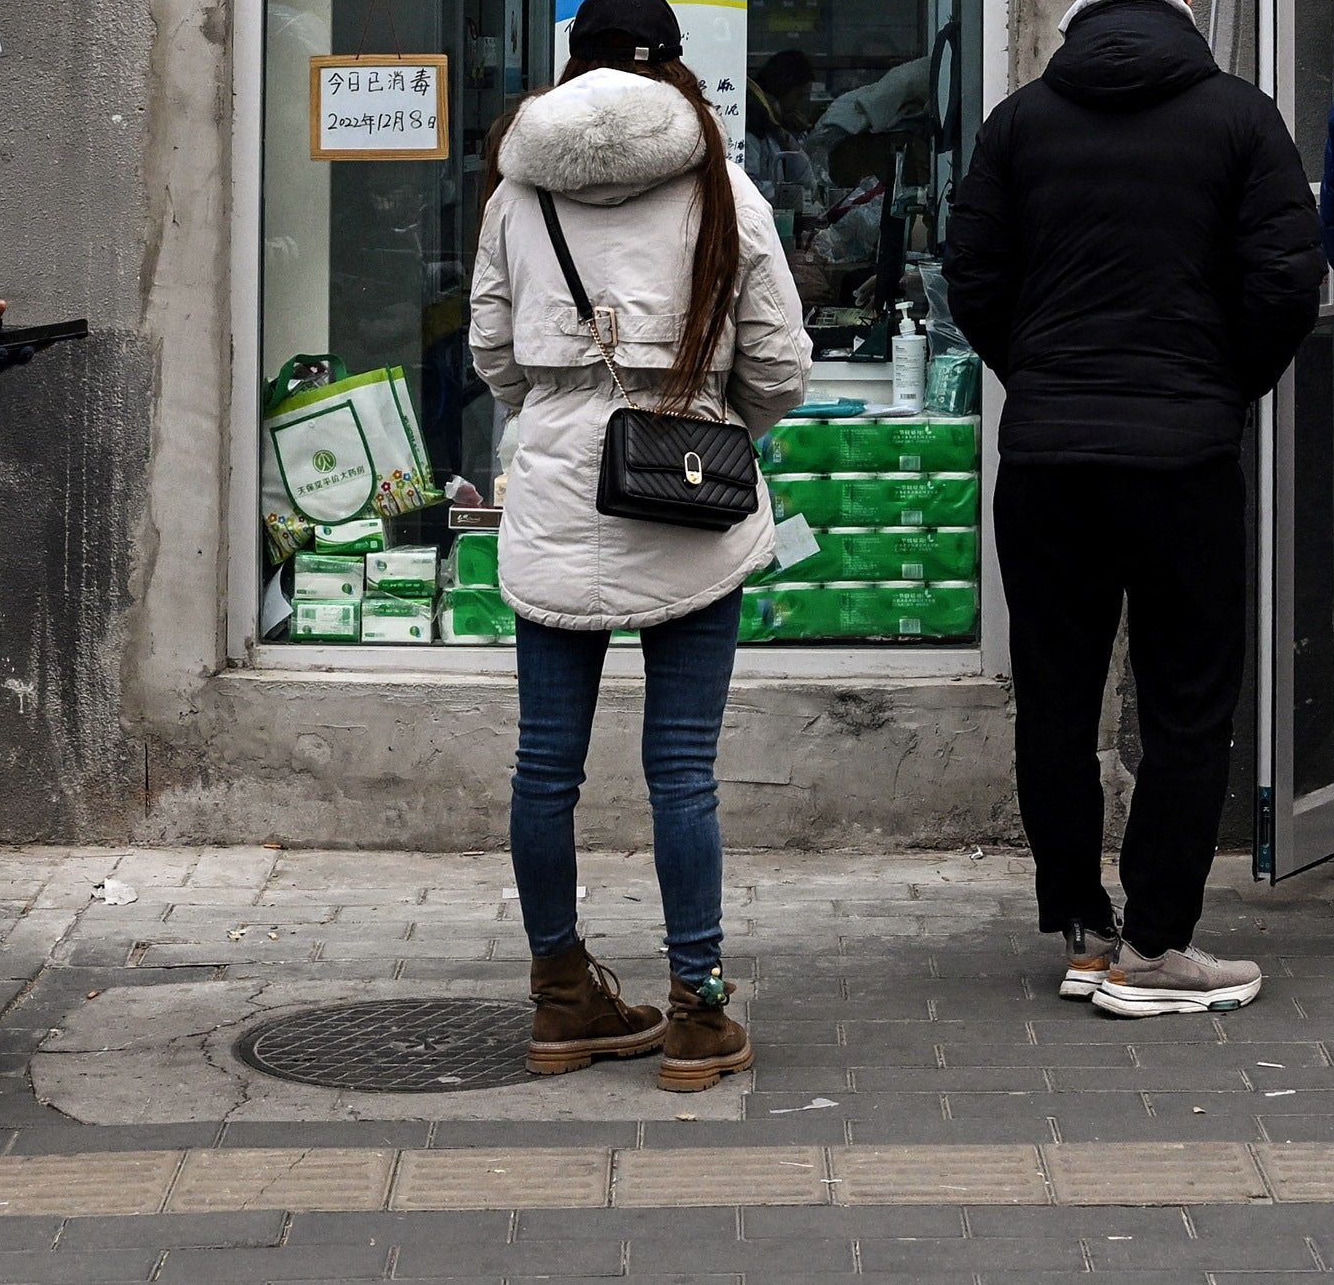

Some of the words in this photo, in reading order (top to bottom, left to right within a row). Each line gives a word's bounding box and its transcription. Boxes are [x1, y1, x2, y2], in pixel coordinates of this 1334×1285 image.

[328, 68, 431, 96] 今日已消毒
[327, 110, 436, 134] 2022年12月8日
[296, 465, 365, 495] 天保堂平价大药房
